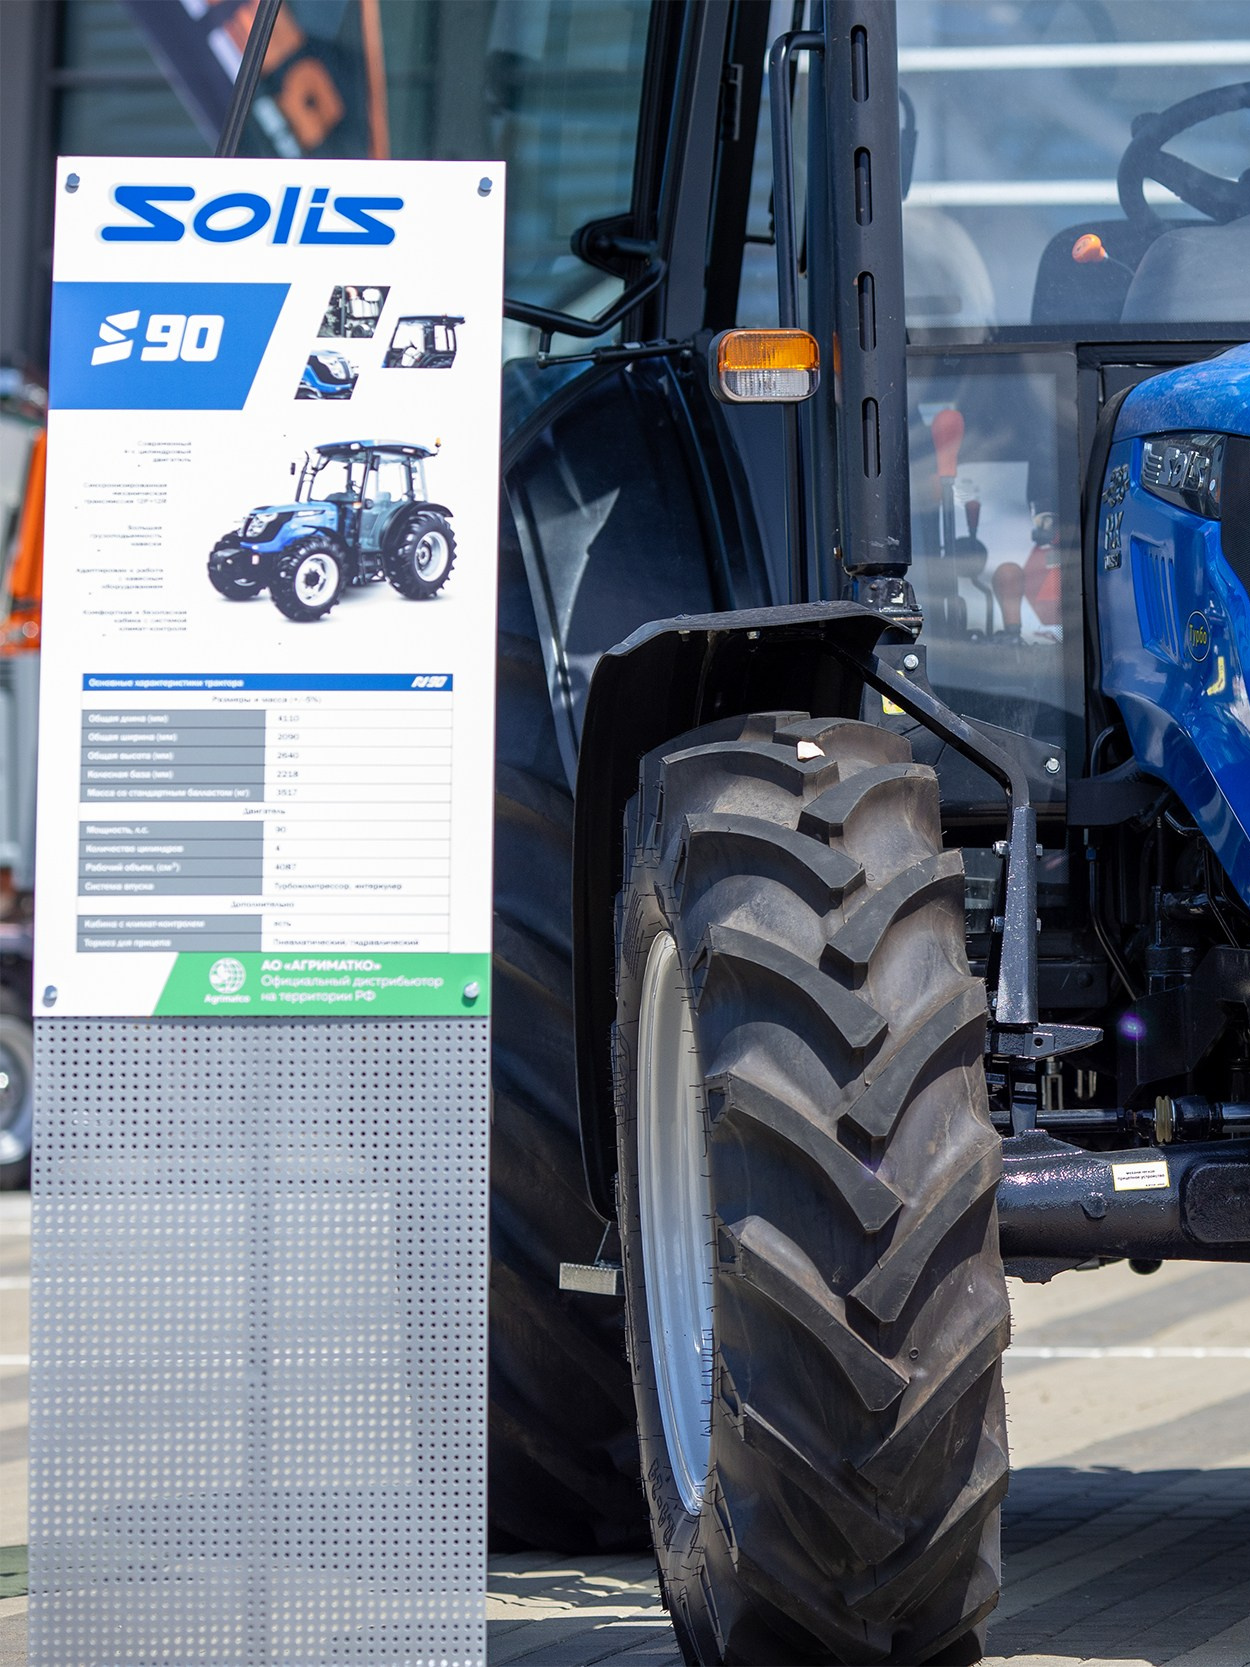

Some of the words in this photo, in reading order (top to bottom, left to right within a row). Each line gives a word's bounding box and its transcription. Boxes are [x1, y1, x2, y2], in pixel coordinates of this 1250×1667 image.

[88, 678, 133, 687] Основные
[135, 679, 203, 688] характеристики
[205, 679, 244, 688] трактора
[261, 959, 282, 971] АО
[284, 959, 382, 972] «АГРИМАТКО»
[261, 976, 352, 989] Официальный
[352, 976, 444, 989] дистрибьютор
[261, 993, 277, 1001] на
[279, 992, 353, 1004] территории
[355, 991, 377, 1002] РФ
